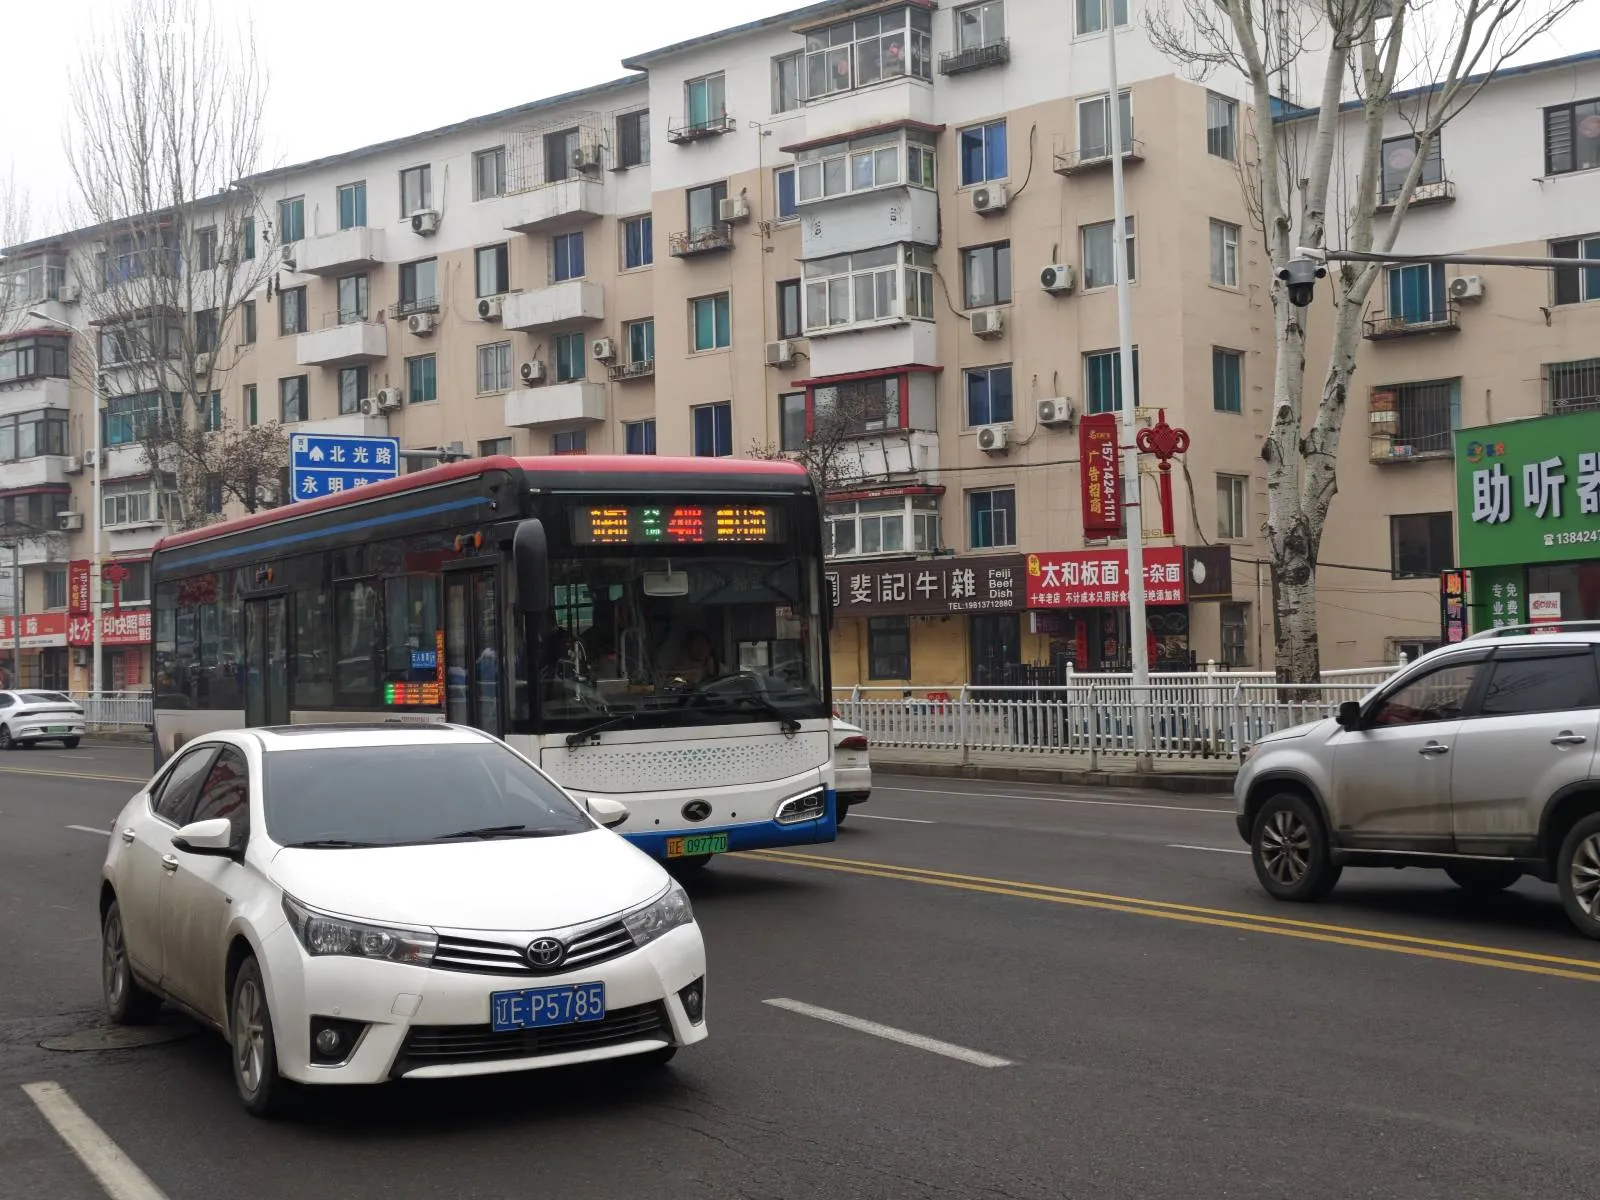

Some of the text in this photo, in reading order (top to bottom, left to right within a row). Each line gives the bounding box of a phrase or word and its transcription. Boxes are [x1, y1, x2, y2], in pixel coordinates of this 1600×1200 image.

[329, 445, 392, 465] 北光路
[1088, 450, 1101, 513] 广告招商
[1102, 441, 1116, 522] 157-1424-1111
[1471, 451, 1600, 525] 助听器
[988, 569, 1011, 579] Feiji
[989, 578, 1013, 589] Beef
[989, 589, 1013, 599] Dish
[1031, 592, 1060, 604] 十年老店
[1065, 590, 1131, 603] 不计成本只用好食
[68, 614, 138, 642] 北方印快照
[496, 989, 601, 1025] 辽E·P5785
